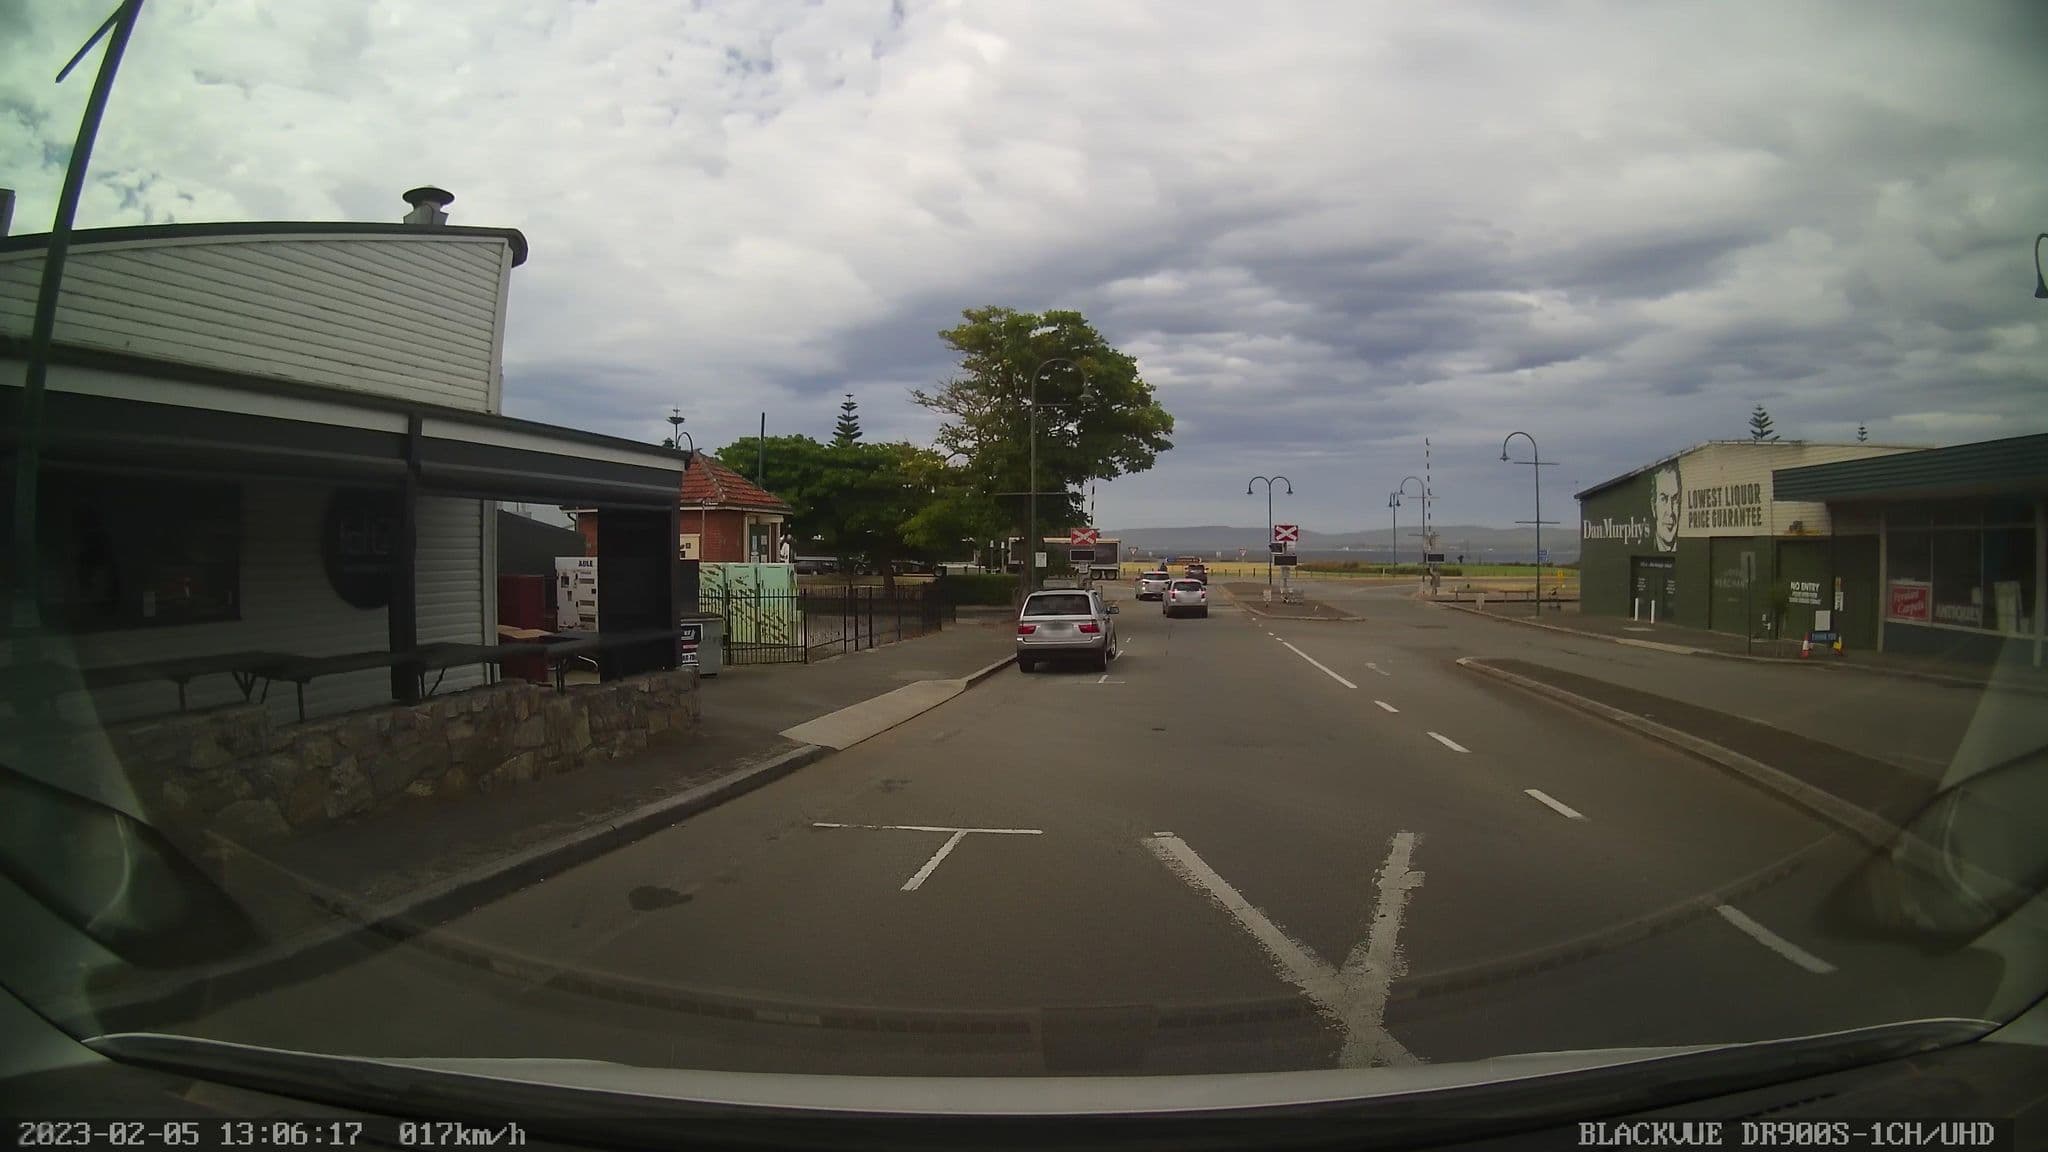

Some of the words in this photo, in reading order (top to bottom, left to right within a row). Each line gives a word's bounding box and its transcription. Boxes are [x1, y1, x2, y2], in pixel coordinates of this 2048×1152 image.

[1687, 487, 1722, 509] LOWEST
[1725, 483, 1761, 508] LIQUOR
[1687, 509, 1710, 528] PRICE
[1711, 507, 1762, 528] GUARANTEE
[1583, 519, 1603, 539] Dan
[1603, 516, 1650, 544] Murphy's
[1790, 582, 1800, 591] NO
[1801, 583, 1820, 592] ENTRY
